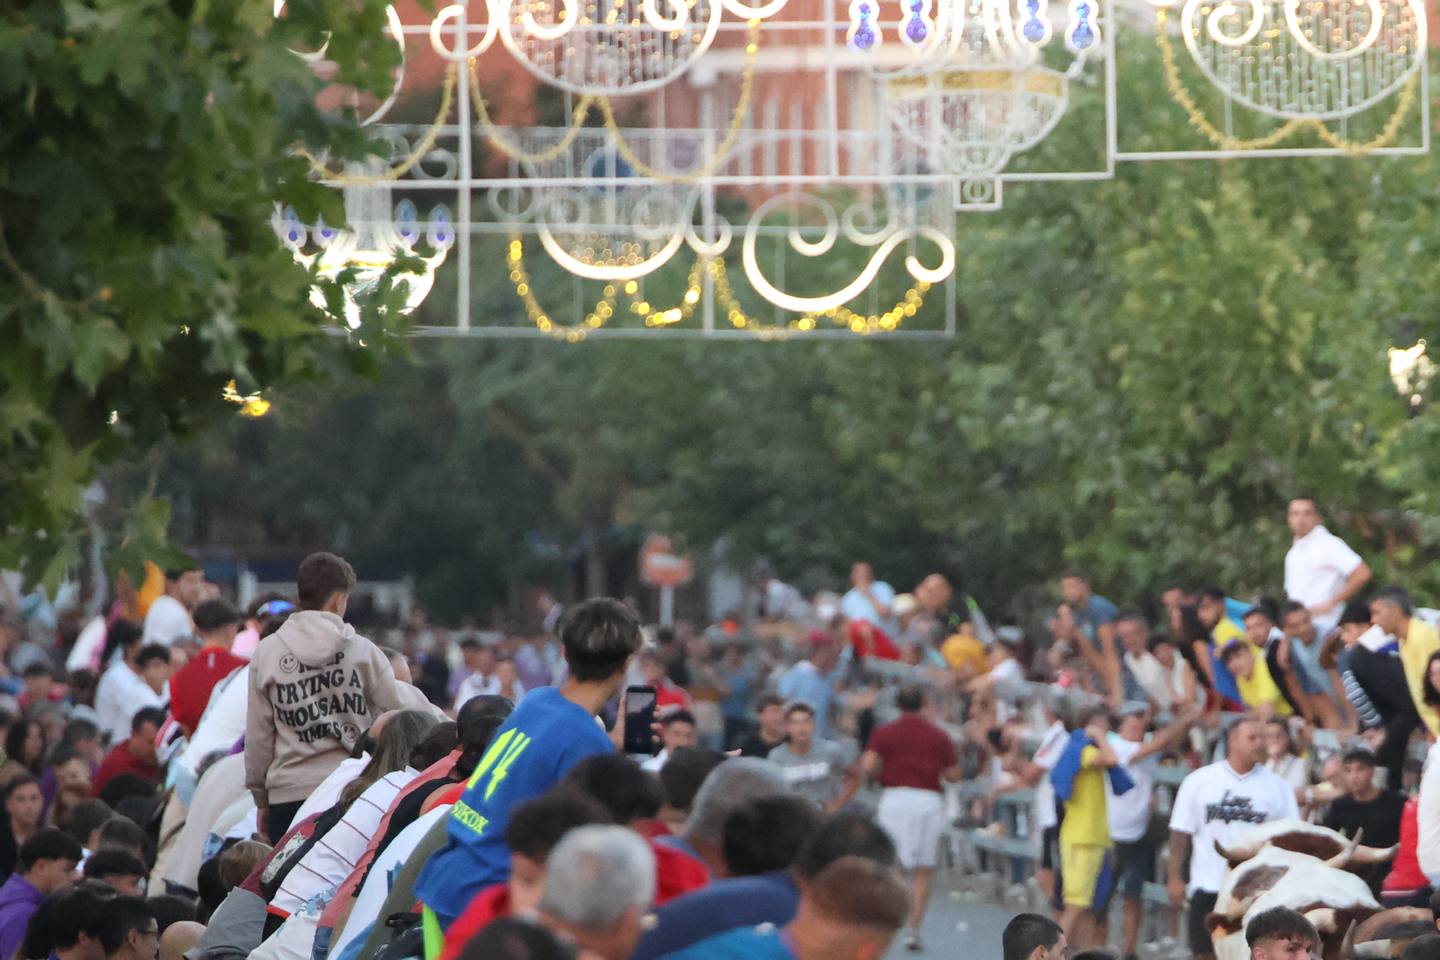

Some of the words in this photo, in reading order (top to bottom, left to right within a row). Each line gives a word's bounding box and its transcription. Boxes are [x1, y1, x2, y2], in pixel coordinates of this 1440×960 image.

[276, 669, 345, 704] TRYING
[349, 669, 361, 688] A
[275, 692, 367, 728] THOUSAND
[296, 721, 342, 743] TIMES
